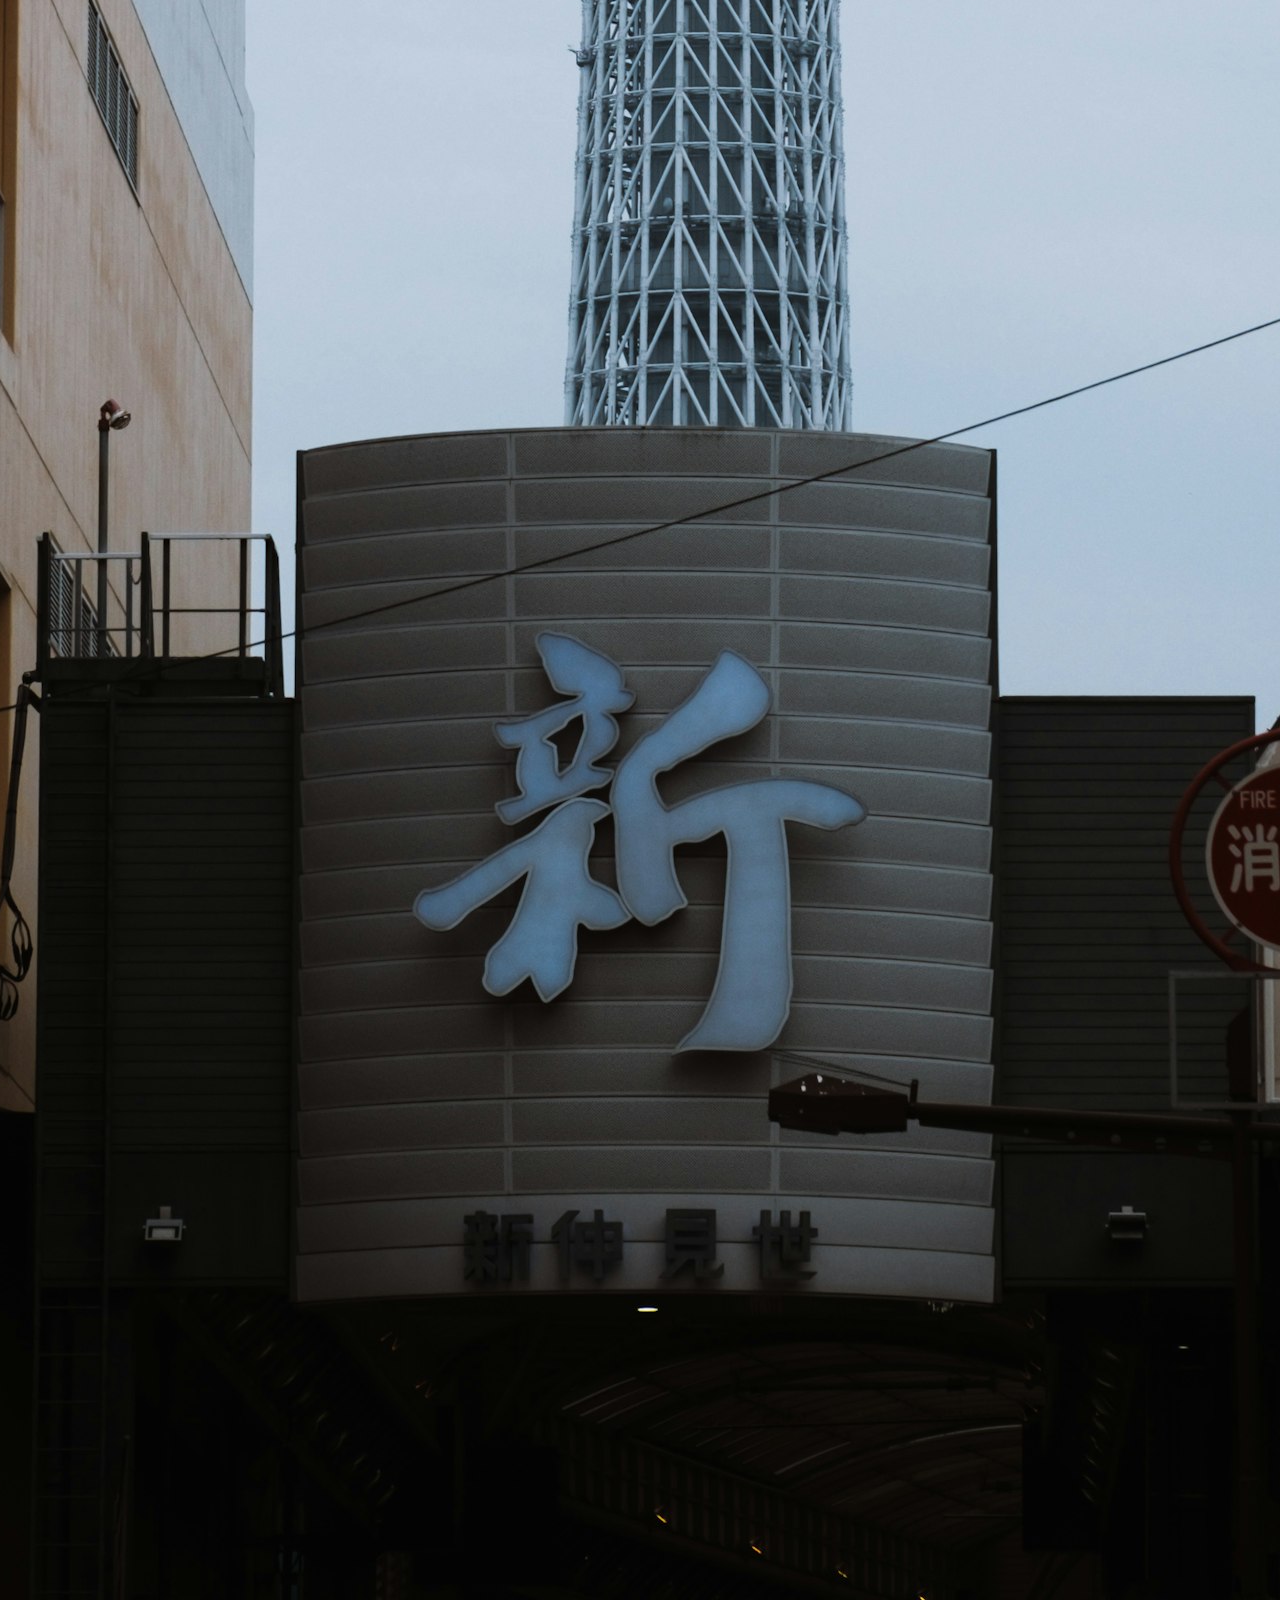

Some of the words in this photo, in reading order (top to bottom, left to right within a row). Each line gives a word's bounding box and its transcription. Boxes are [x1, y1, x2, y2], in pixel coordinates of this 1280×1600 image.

[1238, 789, 1277, 810] FIRE
[413, 631, 869, 1055] 新
[463, 1207, 819, 1282] 新仲見世
